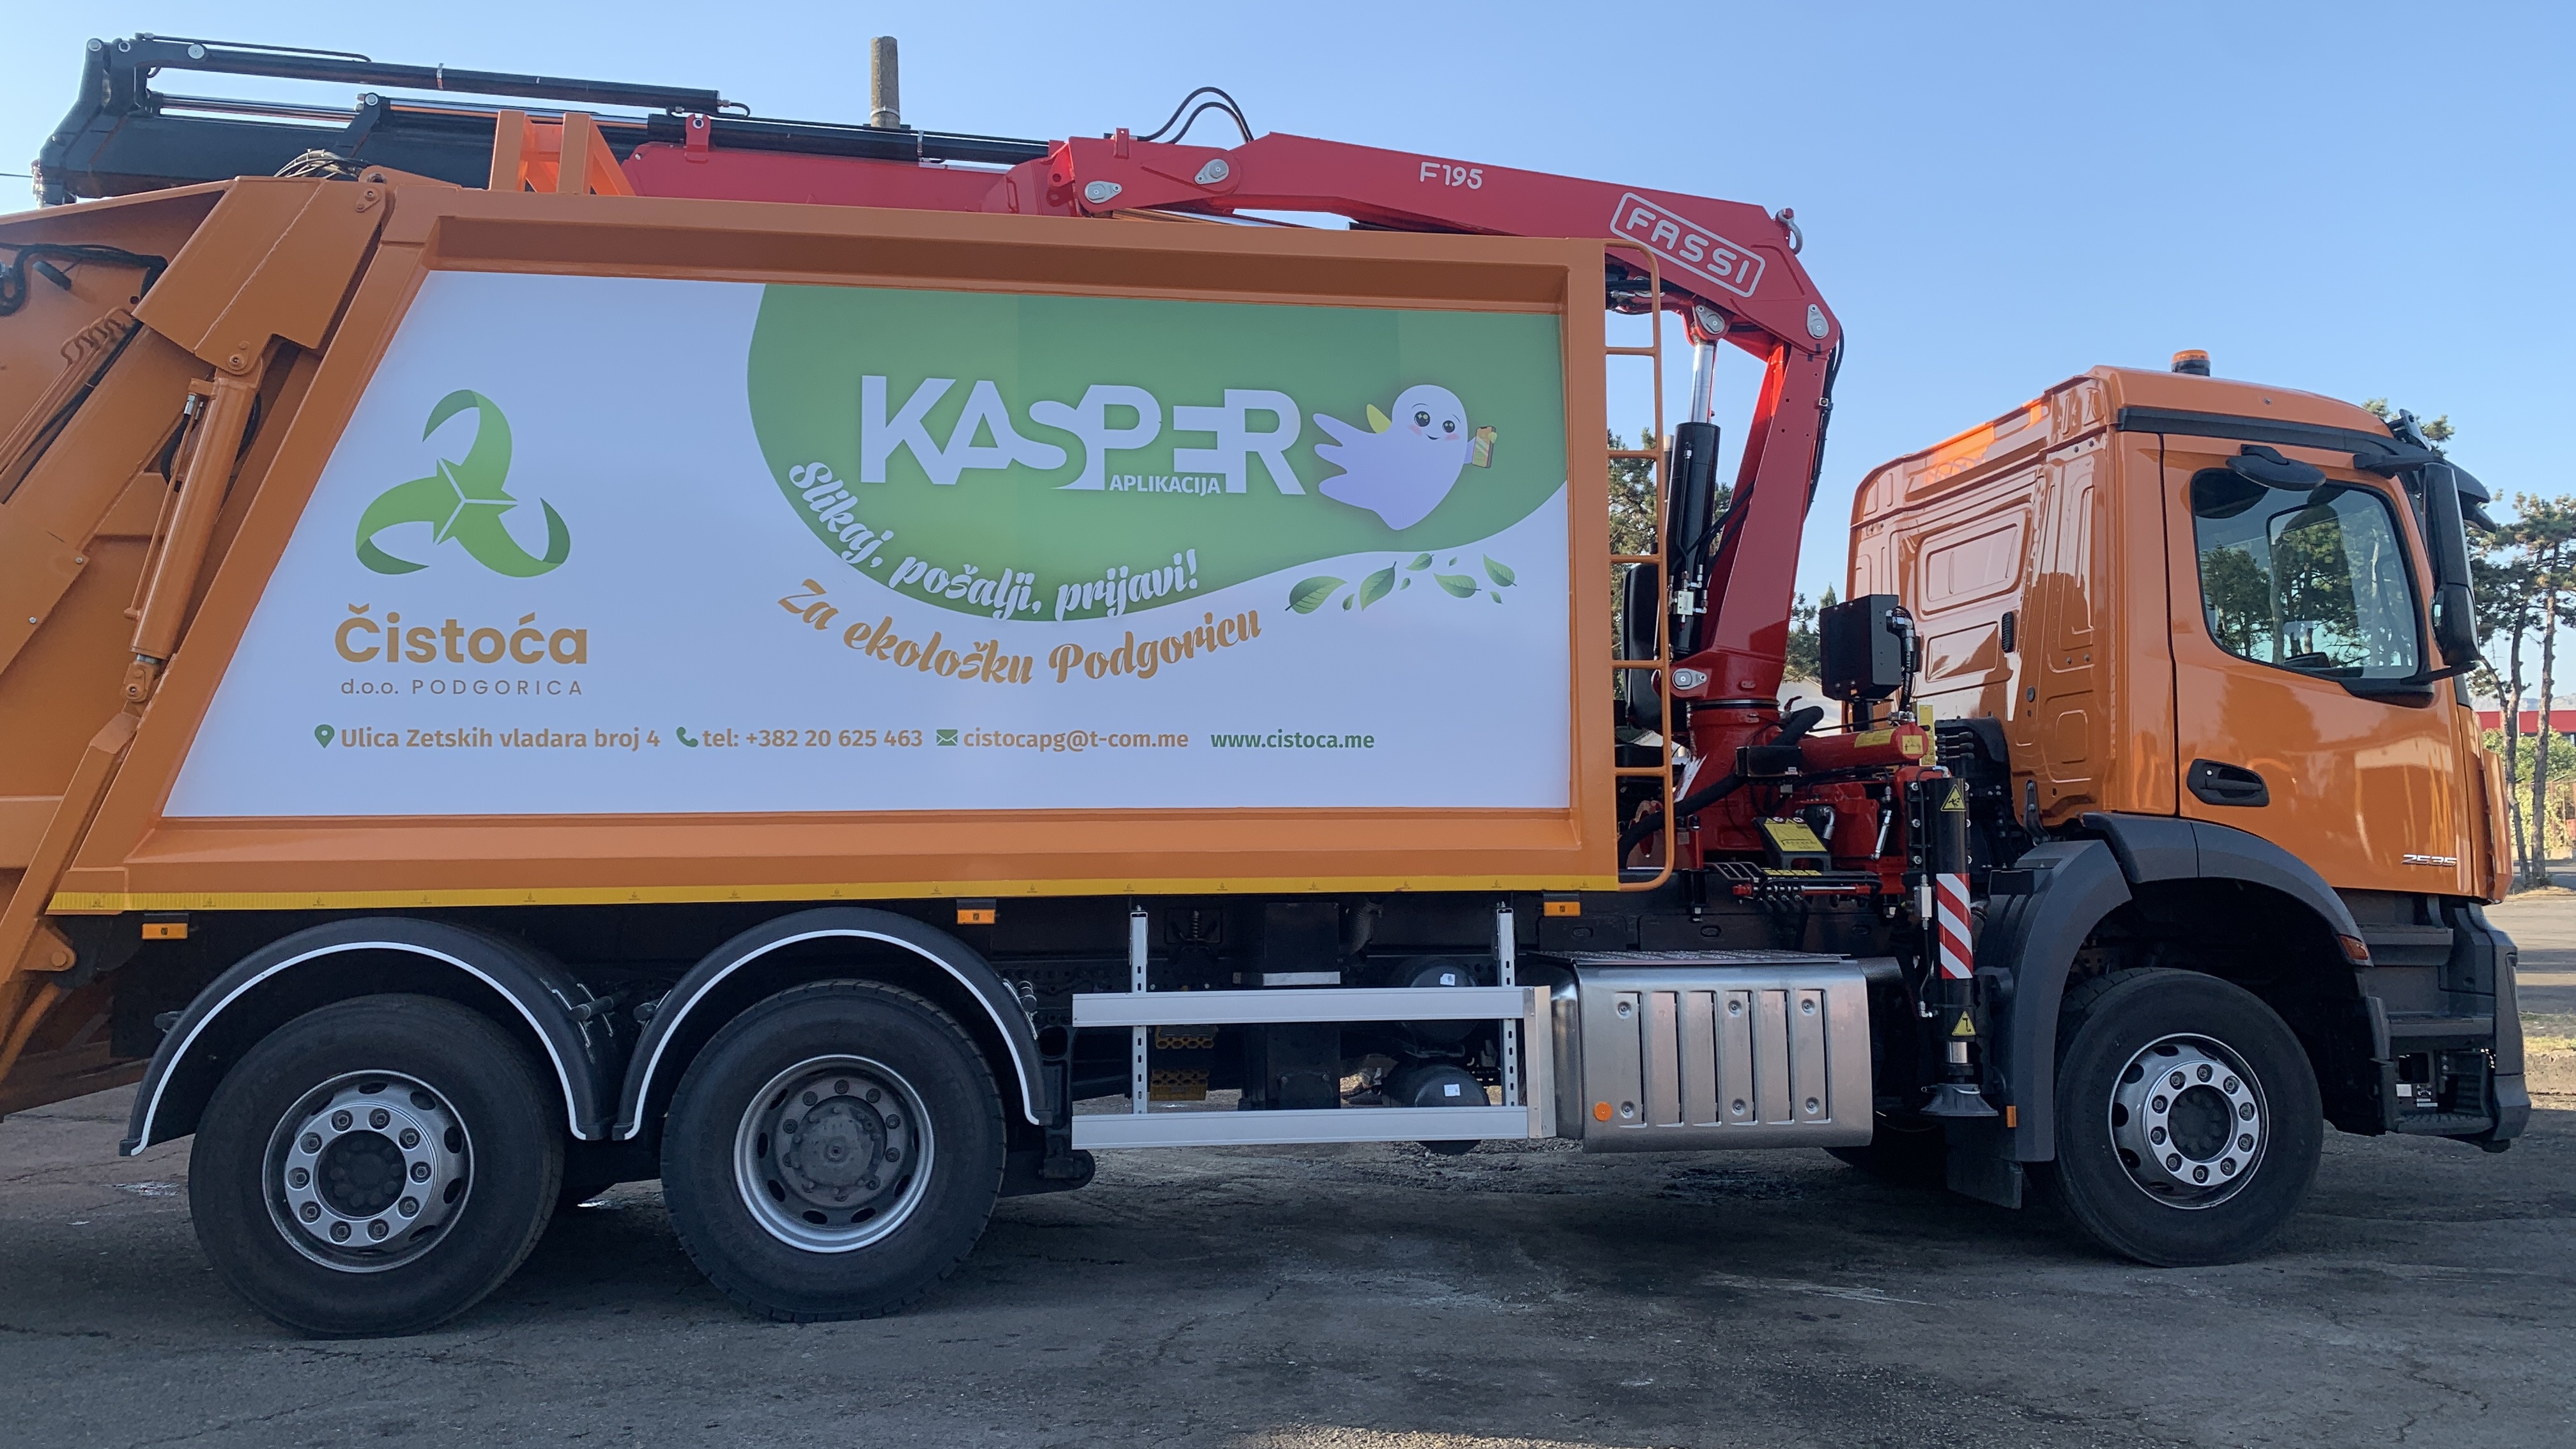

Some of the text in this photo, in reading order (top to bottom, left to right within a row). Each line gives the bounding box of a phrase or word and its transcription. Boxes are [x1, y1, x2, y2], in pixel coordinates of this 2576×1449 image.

[1419, 161, 1483, 190] F195
[1625, 206, 1750, 284] FASSI
[861, 374, 1307, 495] KASPER
[1108, 474, 1222, 496] APLIKACIJA
[788, 461, 1198, 622] Slikaj, pošalji, prijavi!
[335, 602, 587, 664] Čistoća
[778, 578, 1262, 684] Za ekološku Podgoricu
[341, 678, 583, 695] d.o.o. PODGORICA
[341, 726, 1374, 752] Ulica Zetskih vladara broj 4 tel: +382 20 625 463 cistocapg@t-com.me www.cistoca.me
[2402, 854, 2457, 866] 2535
